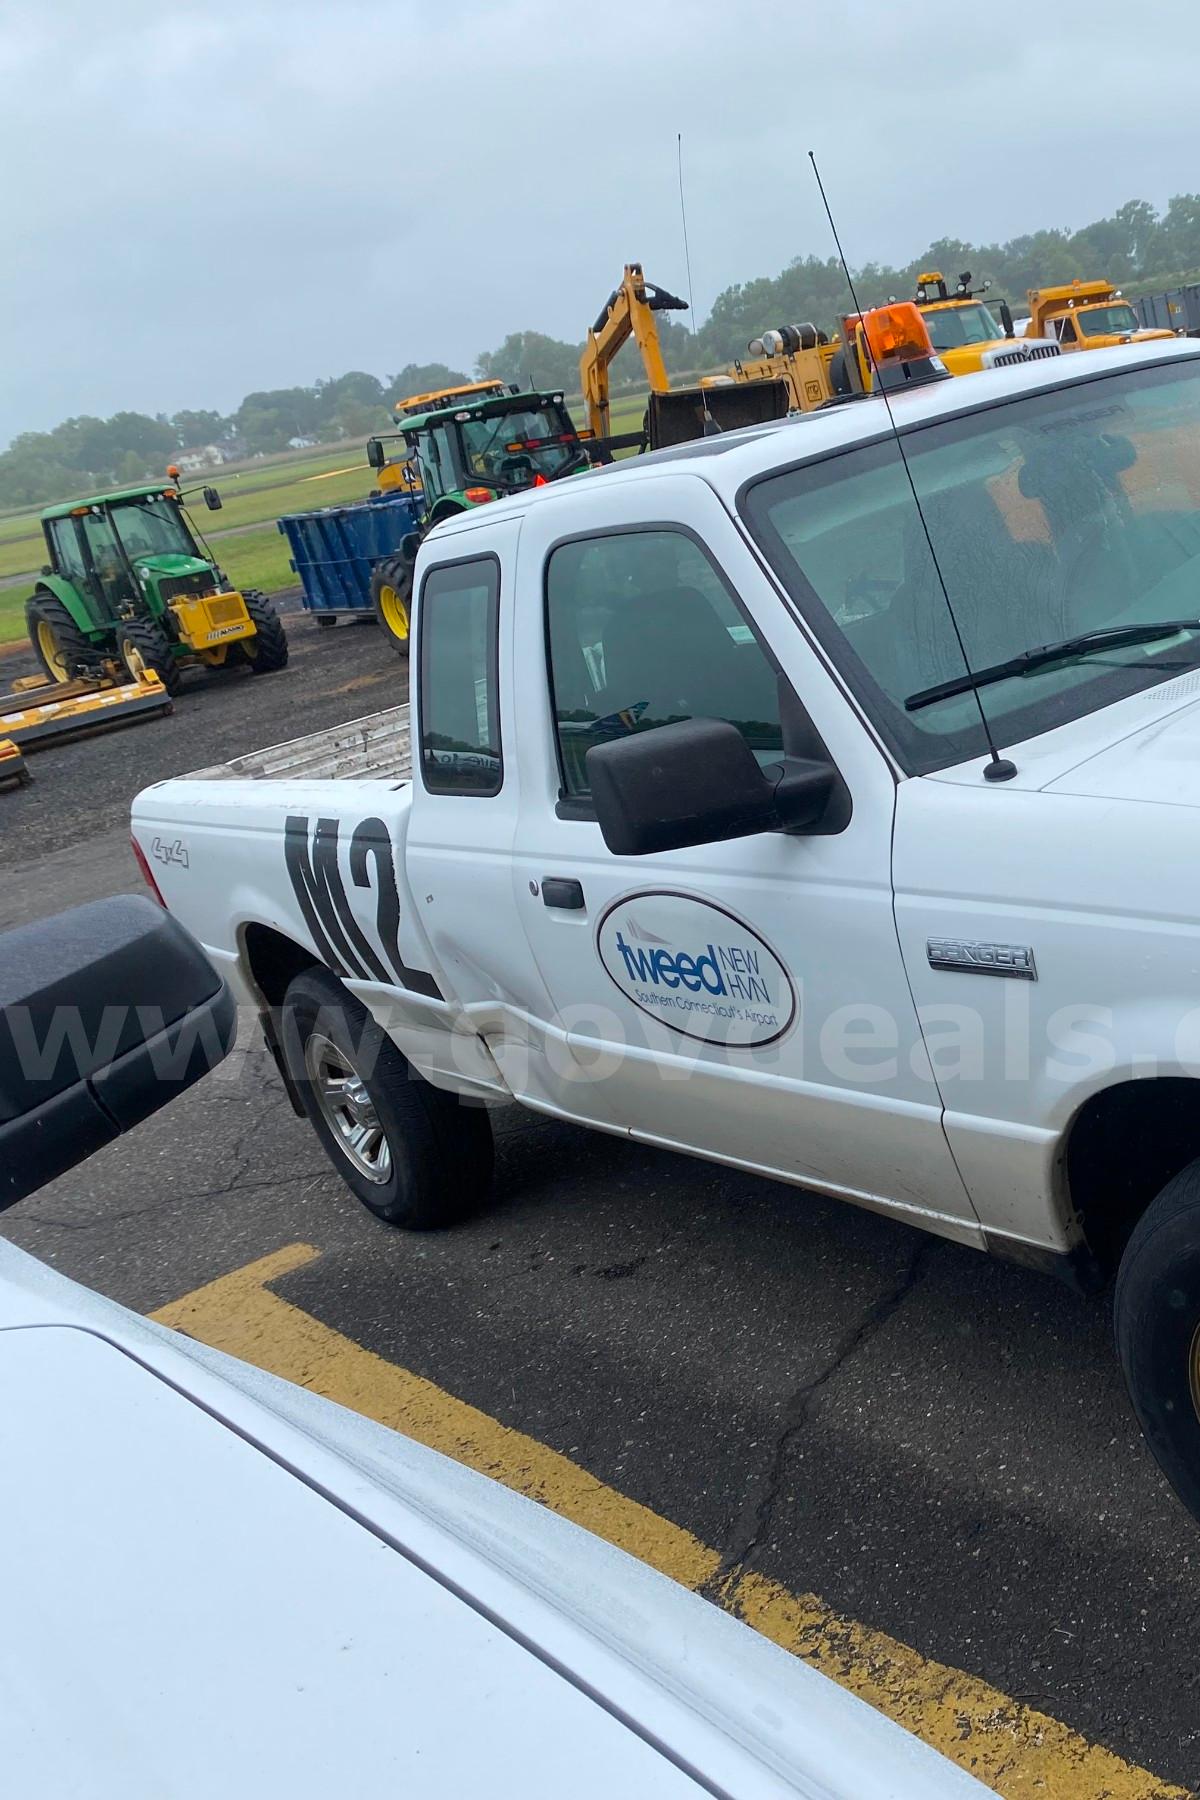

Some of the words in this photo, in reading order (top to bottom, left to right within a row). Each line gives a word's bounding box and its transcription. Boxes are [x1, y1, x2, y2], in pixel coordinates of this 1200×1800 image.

[151, 836, 189, 869] 4x4
[285, 815, 446, 1002] M2
[615, 931, 729, 997] tweed
[718, 945, 761, 976] NEW
[726, 972, 771, 1004] HVN
[635, 988, 675, 1008] Southern
[676, 996, 744, 1021] Connecticut's
[745, 1009, 779, 1027] Airport
